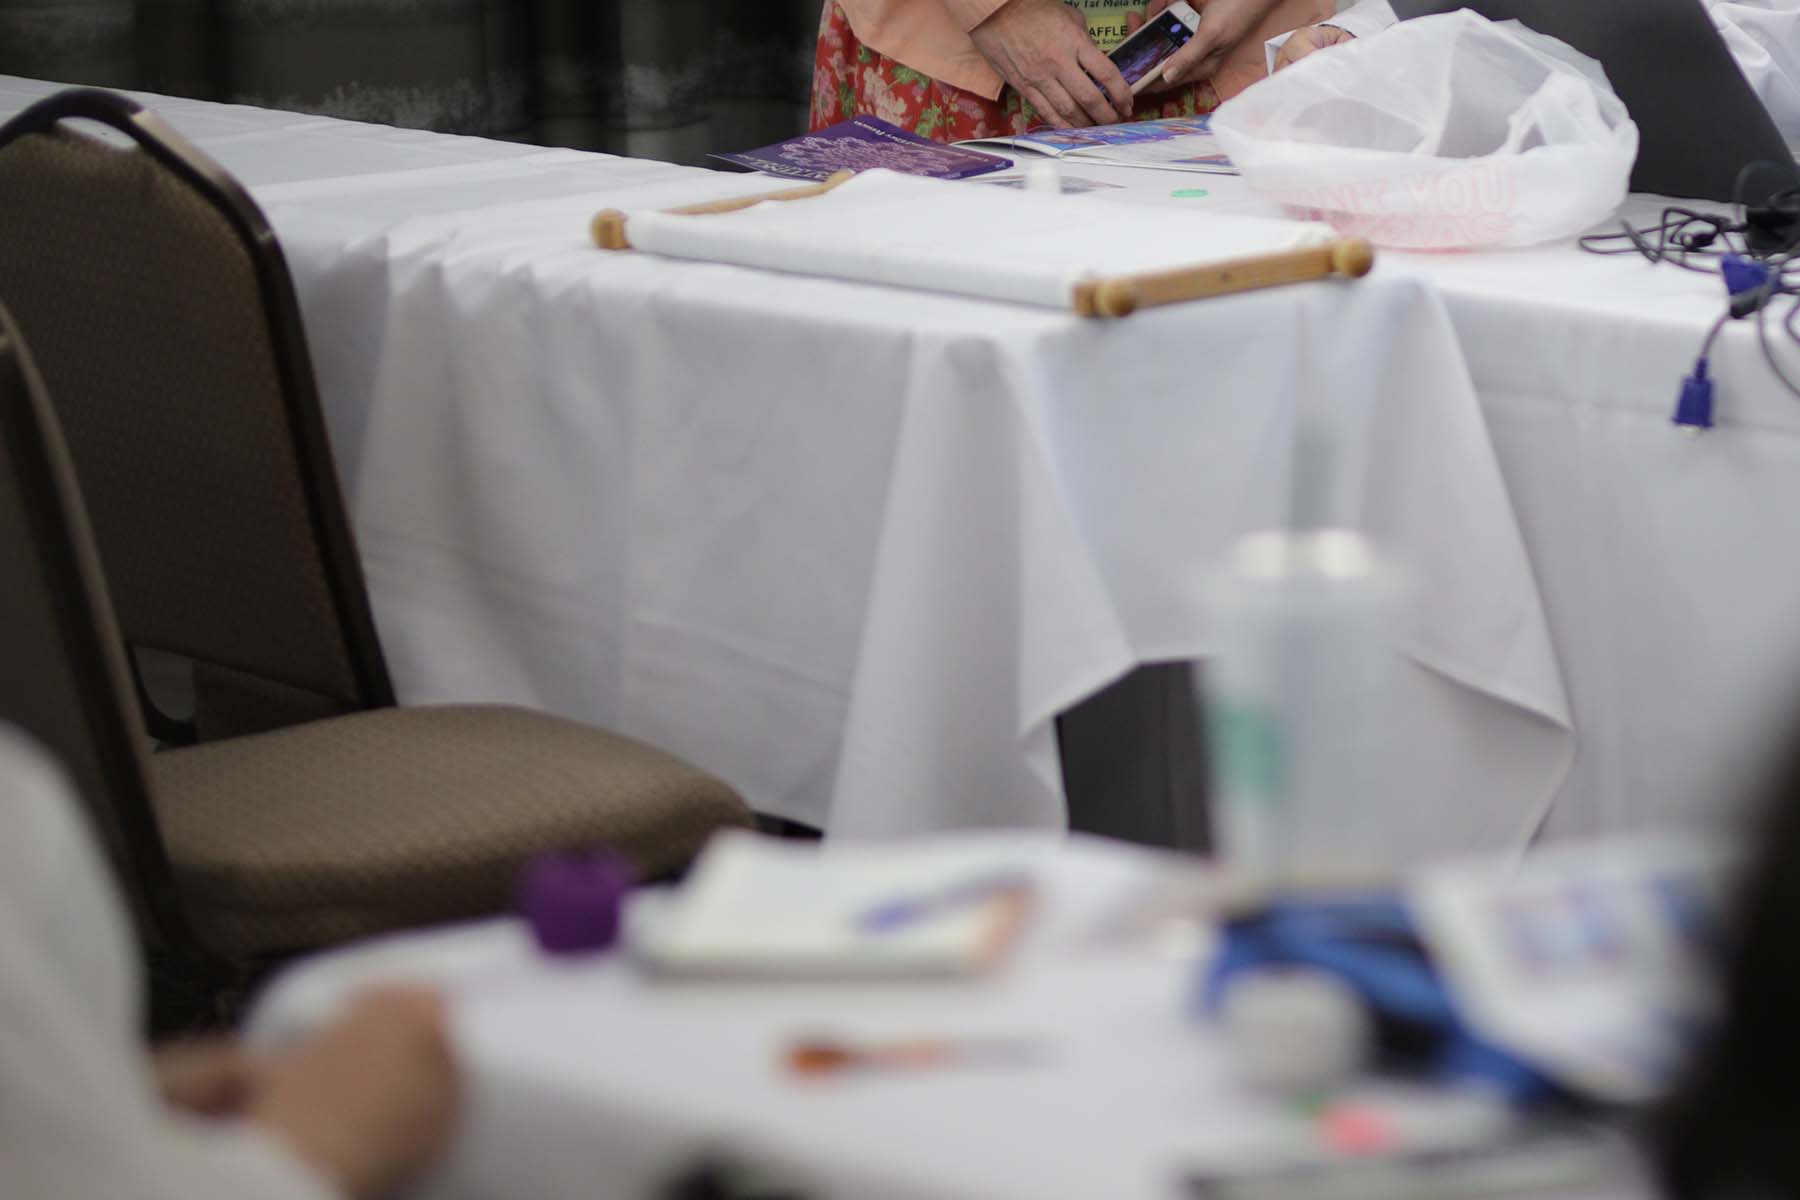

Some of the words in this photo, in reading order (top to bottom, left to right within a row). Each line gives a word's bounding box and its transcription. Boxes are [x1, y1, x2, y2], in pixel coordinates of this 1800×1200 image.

[1084, 0, 1099, 8] 1st
[1089, 25, 1128, 37] AFFLE
[1399, 162, 1514, 214] YOU
